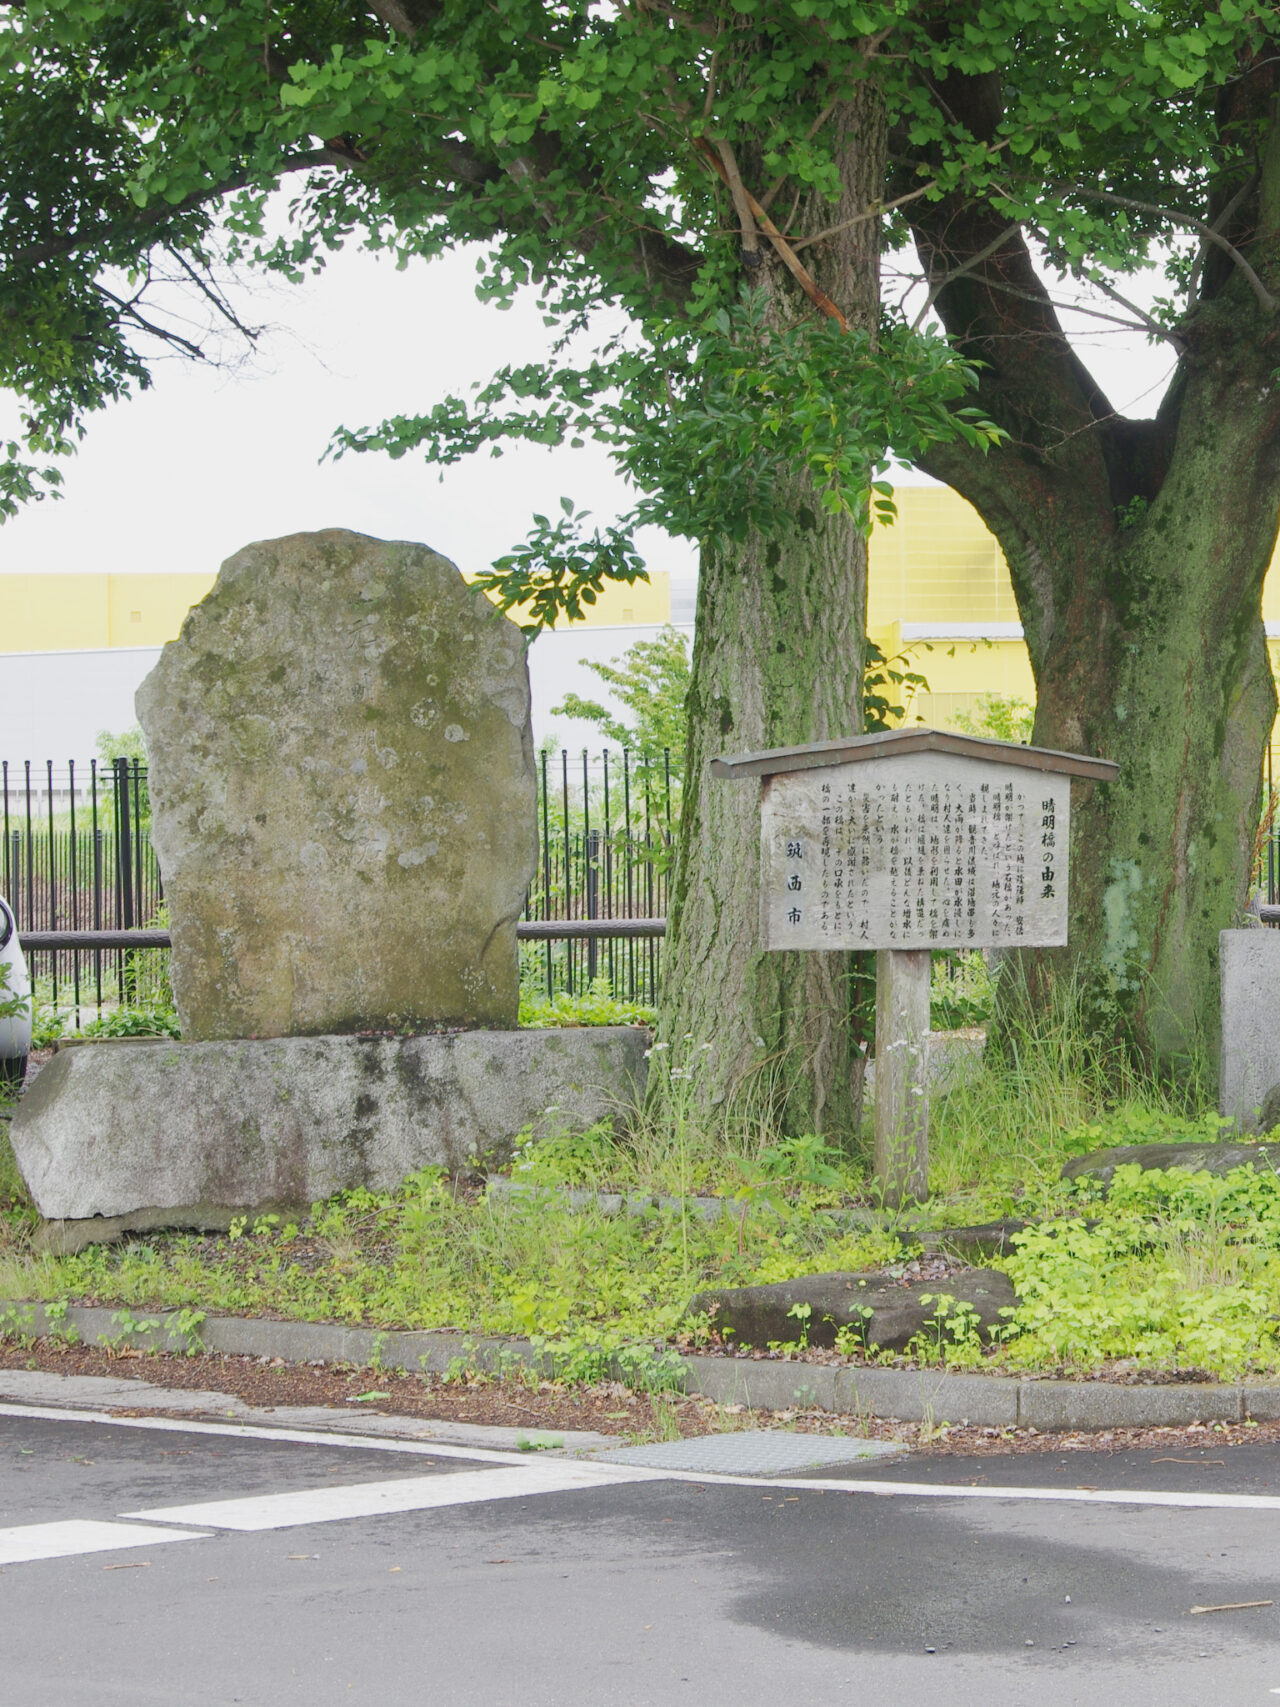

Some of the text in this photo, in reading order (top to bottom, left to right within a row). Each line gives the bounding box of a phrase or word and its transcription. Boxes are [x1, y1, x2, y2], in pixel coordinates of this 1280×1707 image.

[786, 841, 803, 926] 筑西市
[1041, 798, 1056, 899] 晴明橋の由来
